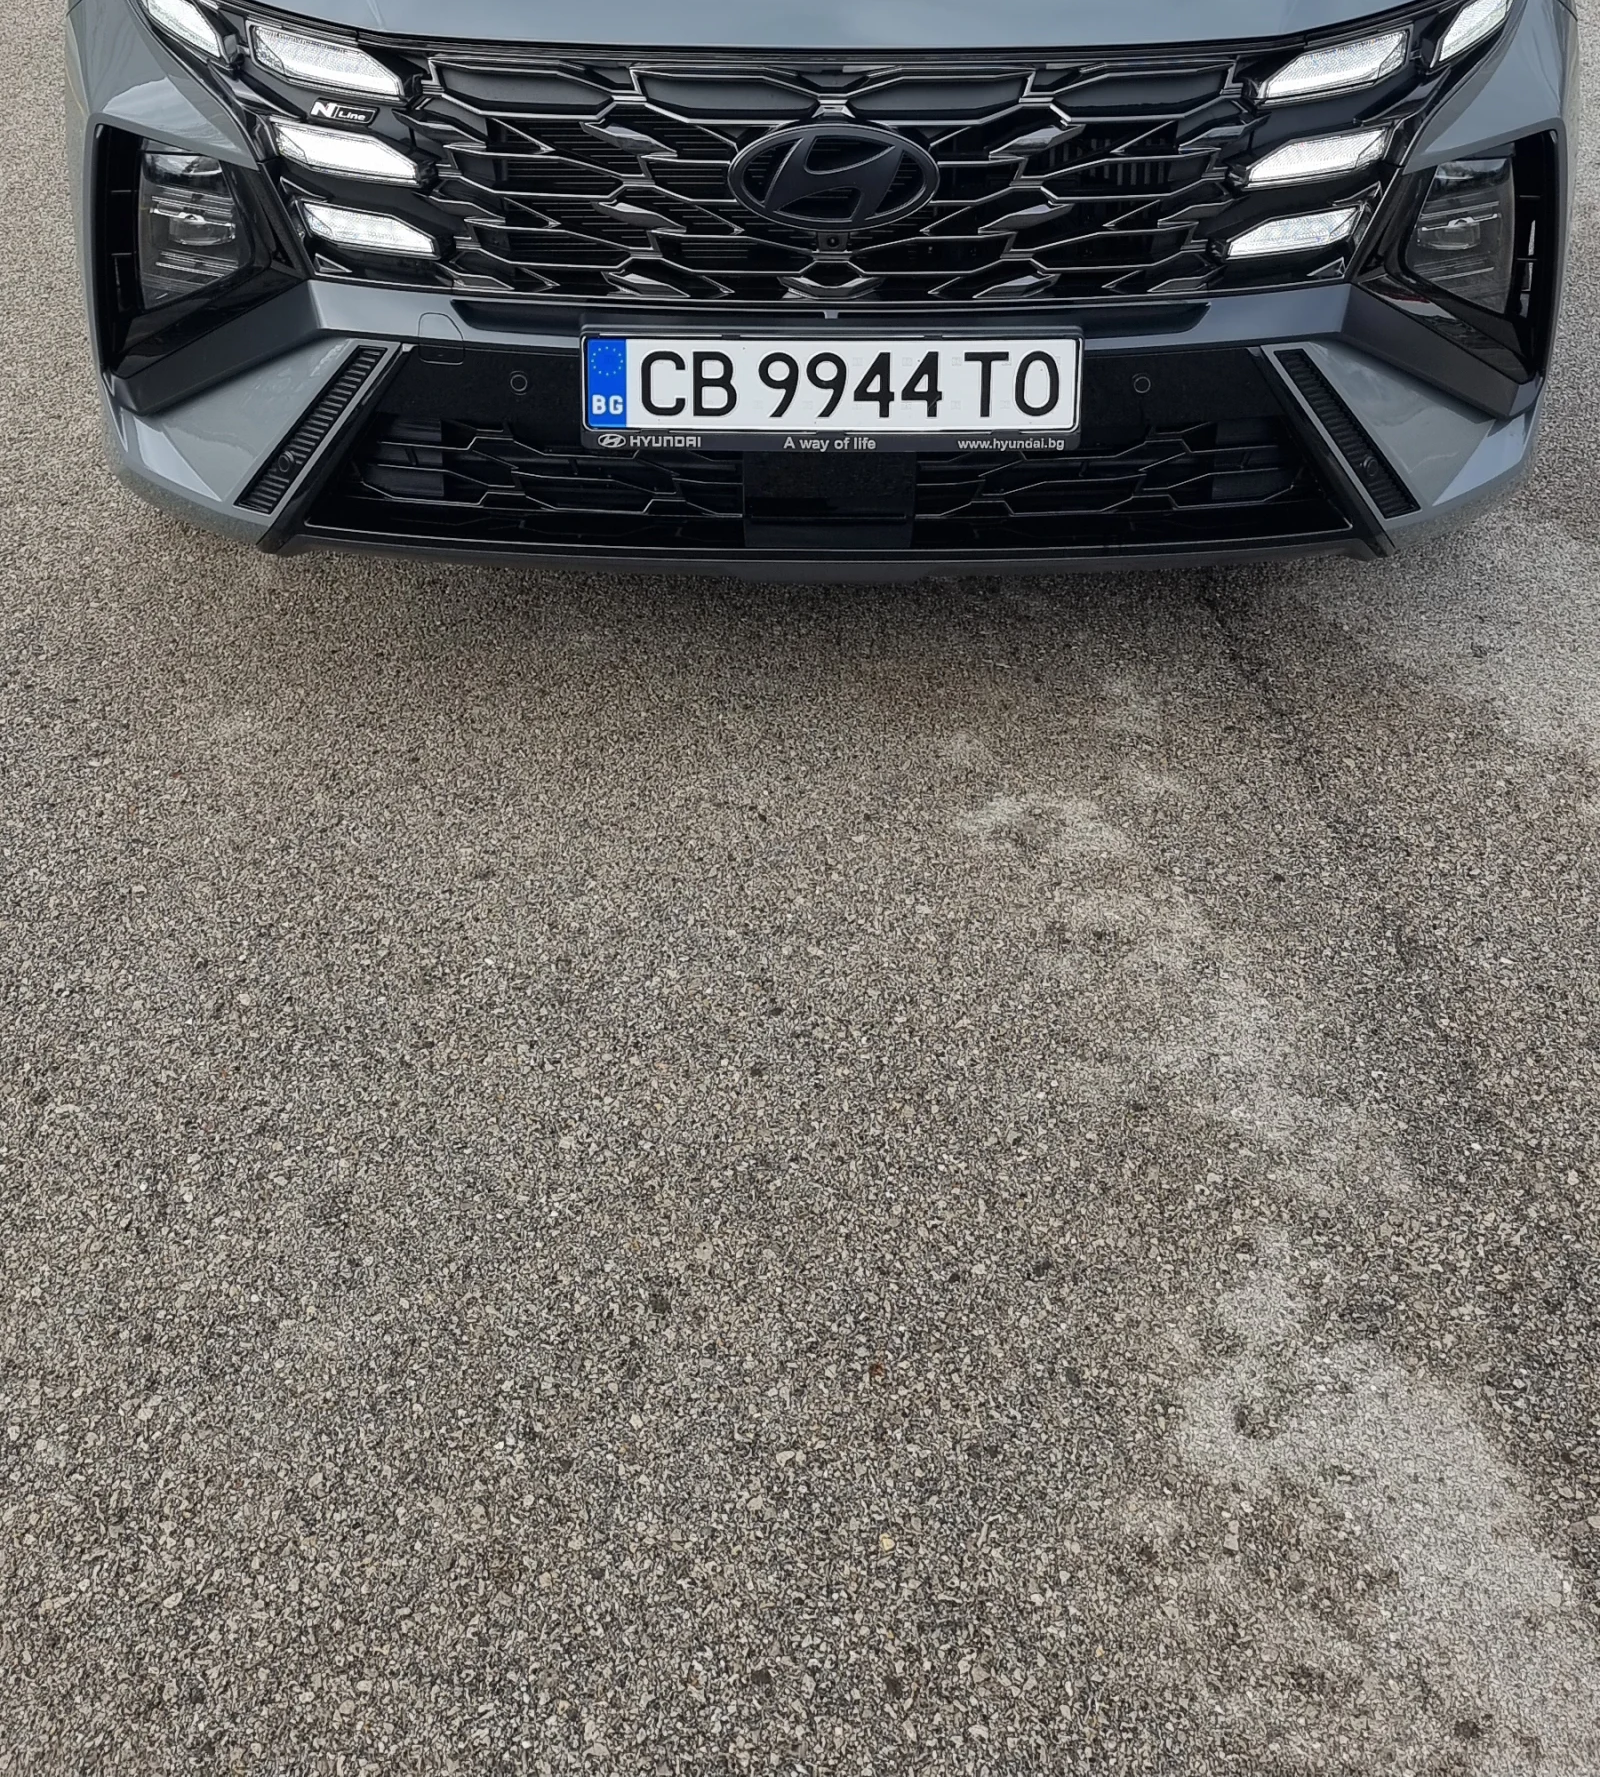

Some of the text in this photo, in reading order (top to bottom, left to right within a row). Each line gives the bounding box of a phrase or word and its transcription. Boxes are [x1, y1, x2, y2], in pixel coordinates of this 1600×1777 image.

[311, 102, 336, 118] N
[640, 350, 1060, 418] CB 9944 TO
[592, 394, 623, 415] BG
[630, 436, 702, 448] HYUNDAI
[783, 436, 876, 453] A way of life
[958, 438, 1065, 452] www.hyundai.bg
